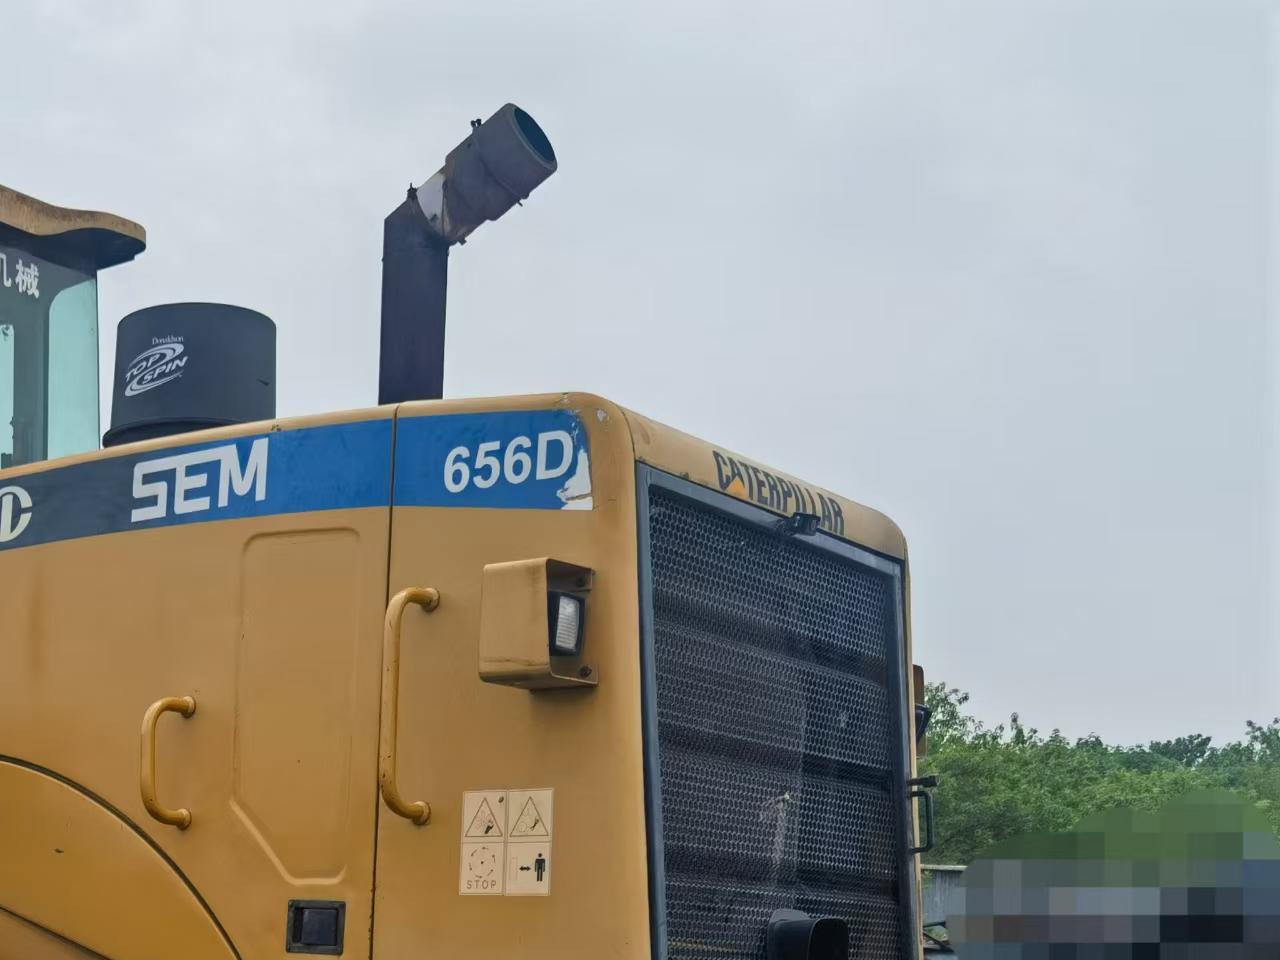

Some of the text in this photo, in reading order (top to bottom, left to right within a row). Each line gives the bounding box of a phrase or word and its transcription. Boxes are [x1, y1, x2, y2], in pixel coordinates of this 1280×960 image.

[125, 353, 161, 383] TOP
[142, 355, 189, 385] SPIN
[131, 437, 269, 523] SEM
[443, 429, 574, 494] 656D
[712, 450, 845, 537] CATERPILLAR
[465, 879, 497, 890] STOP
